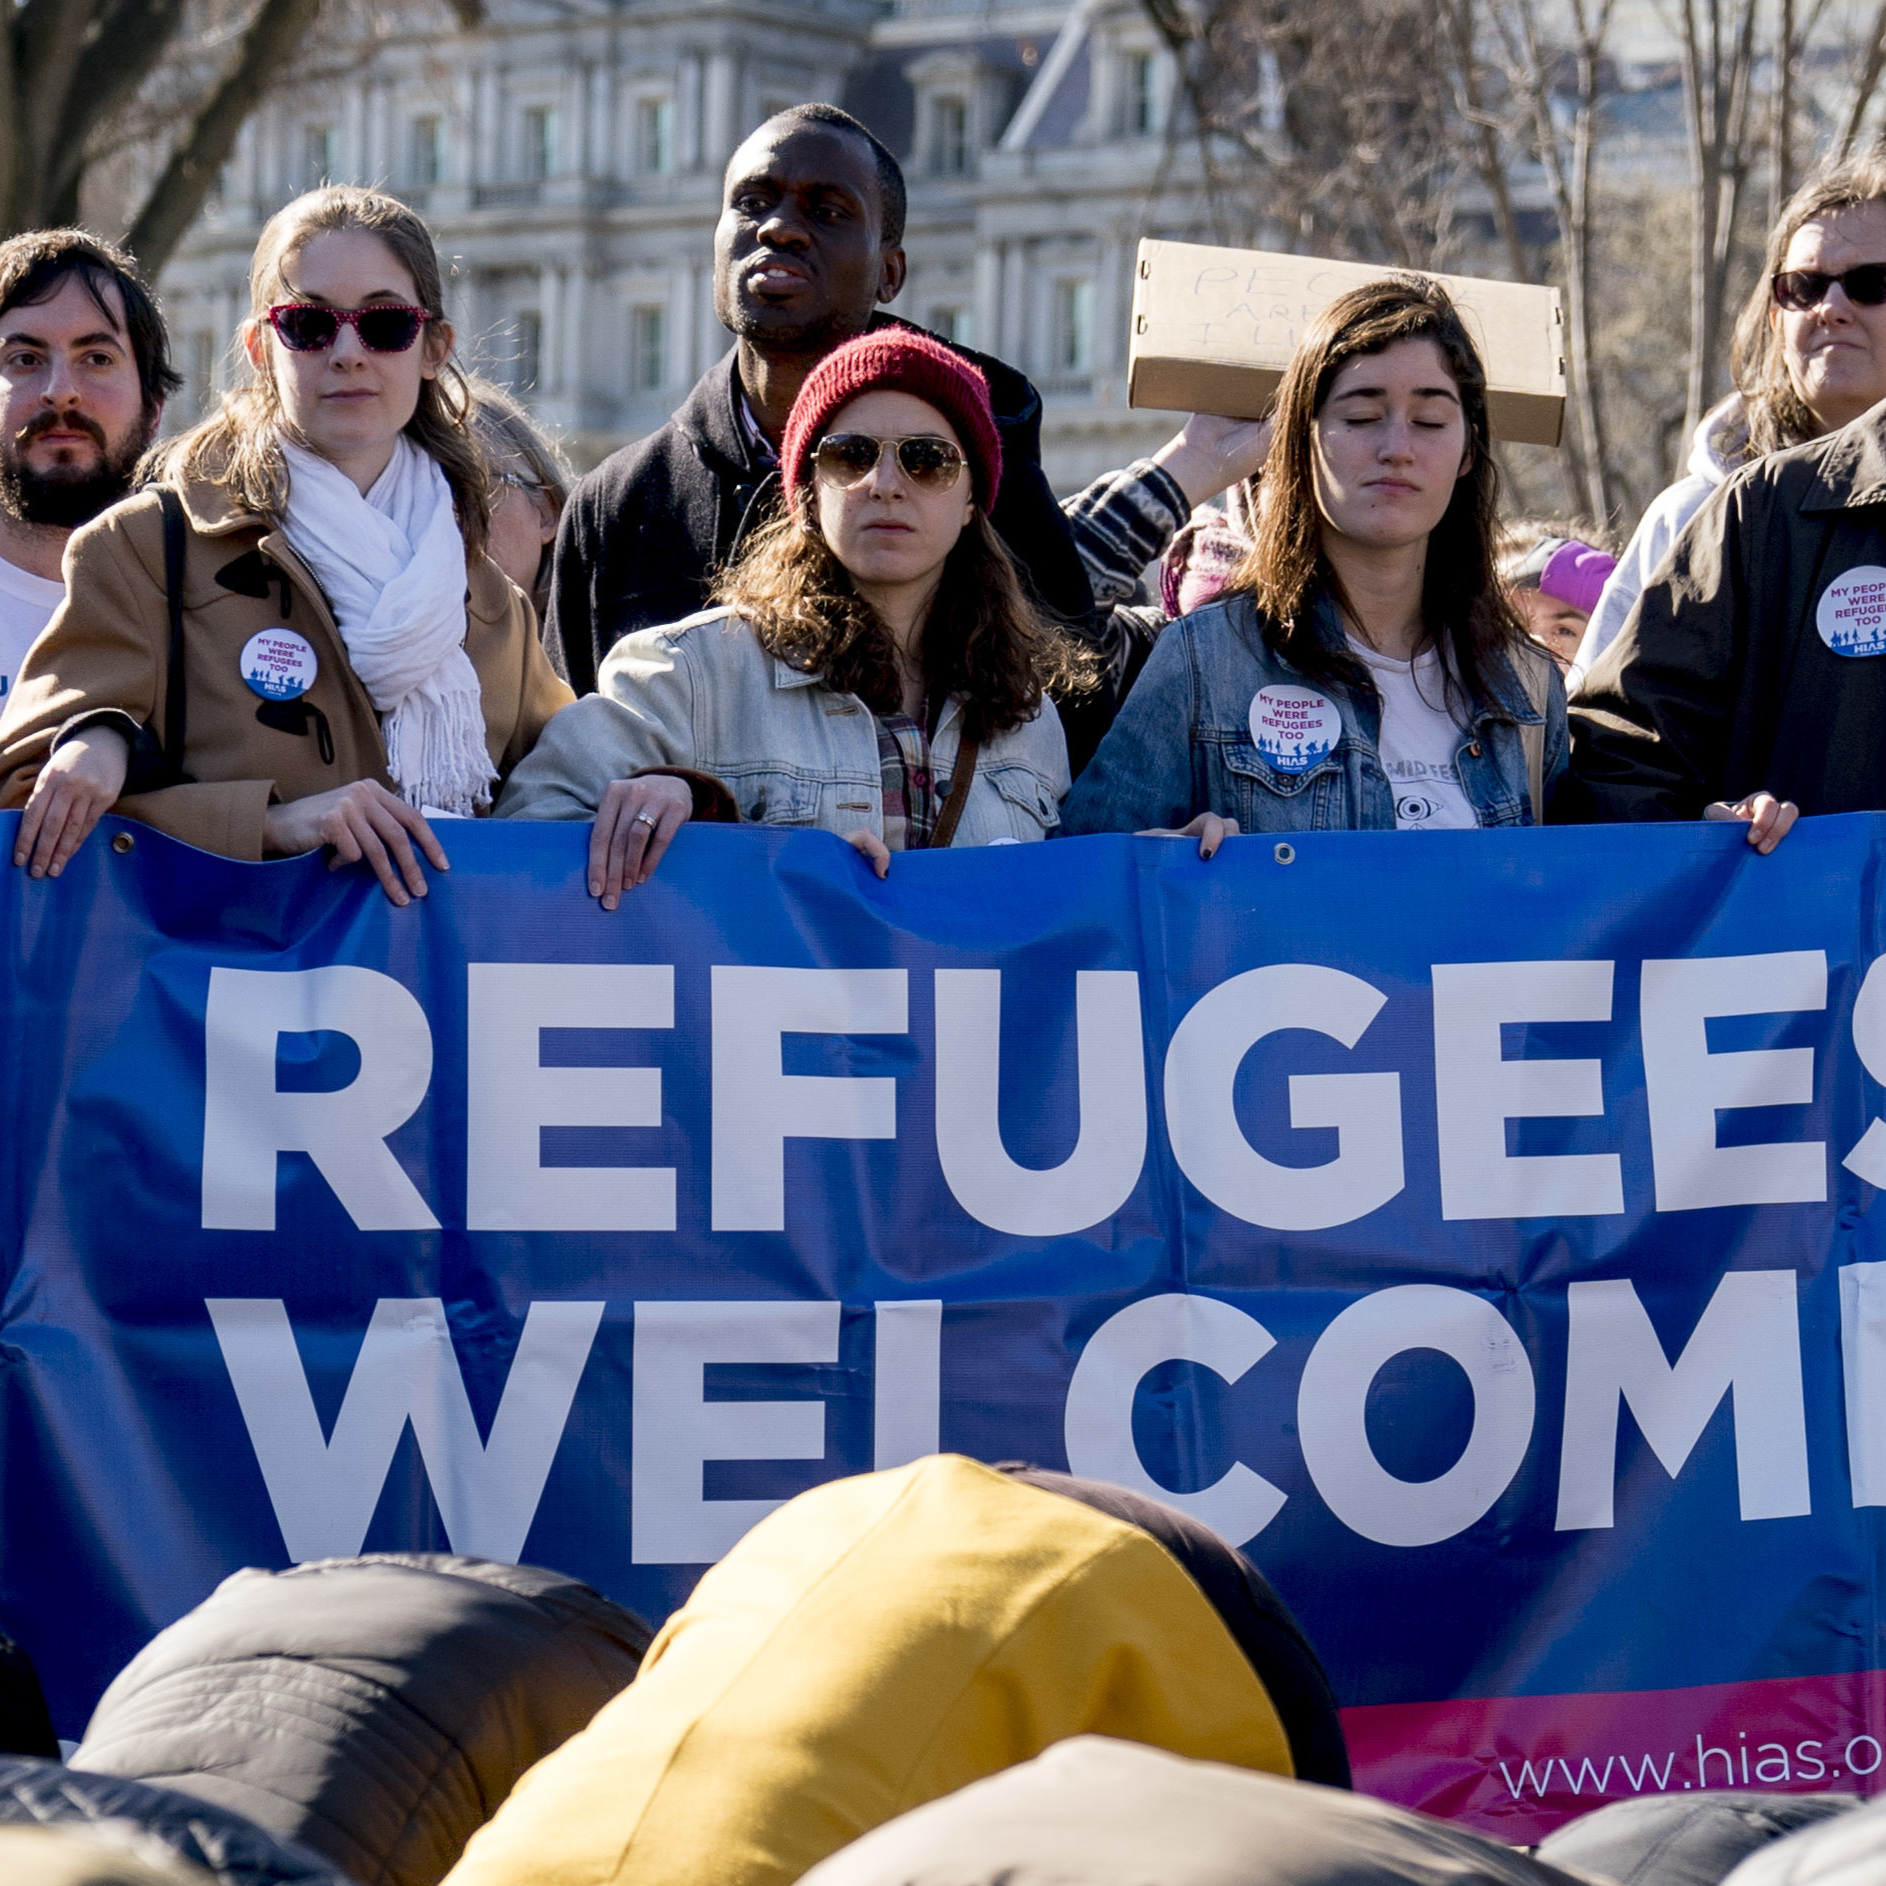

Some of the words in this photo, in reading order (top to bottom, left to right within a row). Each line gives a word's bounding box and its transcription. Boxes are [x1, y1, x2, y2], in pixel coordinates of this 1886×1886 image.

[1831, 587, 1849, 598] MY
[1848, 593, 1886, 606] WERE
[1854, 615, 1882, 627] TOO
[257, 637, 272, 646] MY
[273, 640, 308, 652] PEOPLE
[1854, 641, 1886, 654] HIAS
[268, 647, 295, 658] WERE
[257, 652, 303, 667] REFUGEES
[269, 663, 289, 673] TOO
[264, 682, 287, 693] HIAS
[1259, 692, 1274, 706] MY
[1276, 698, 1325, 709] PEOPLE
[1272, 708, 1309, 719] WERE
[1261, 715, 1323, 730] REFUGEES
[1277, 730, 1305, 741] TOO
[1276, 756, 1309, 767] HIAS
